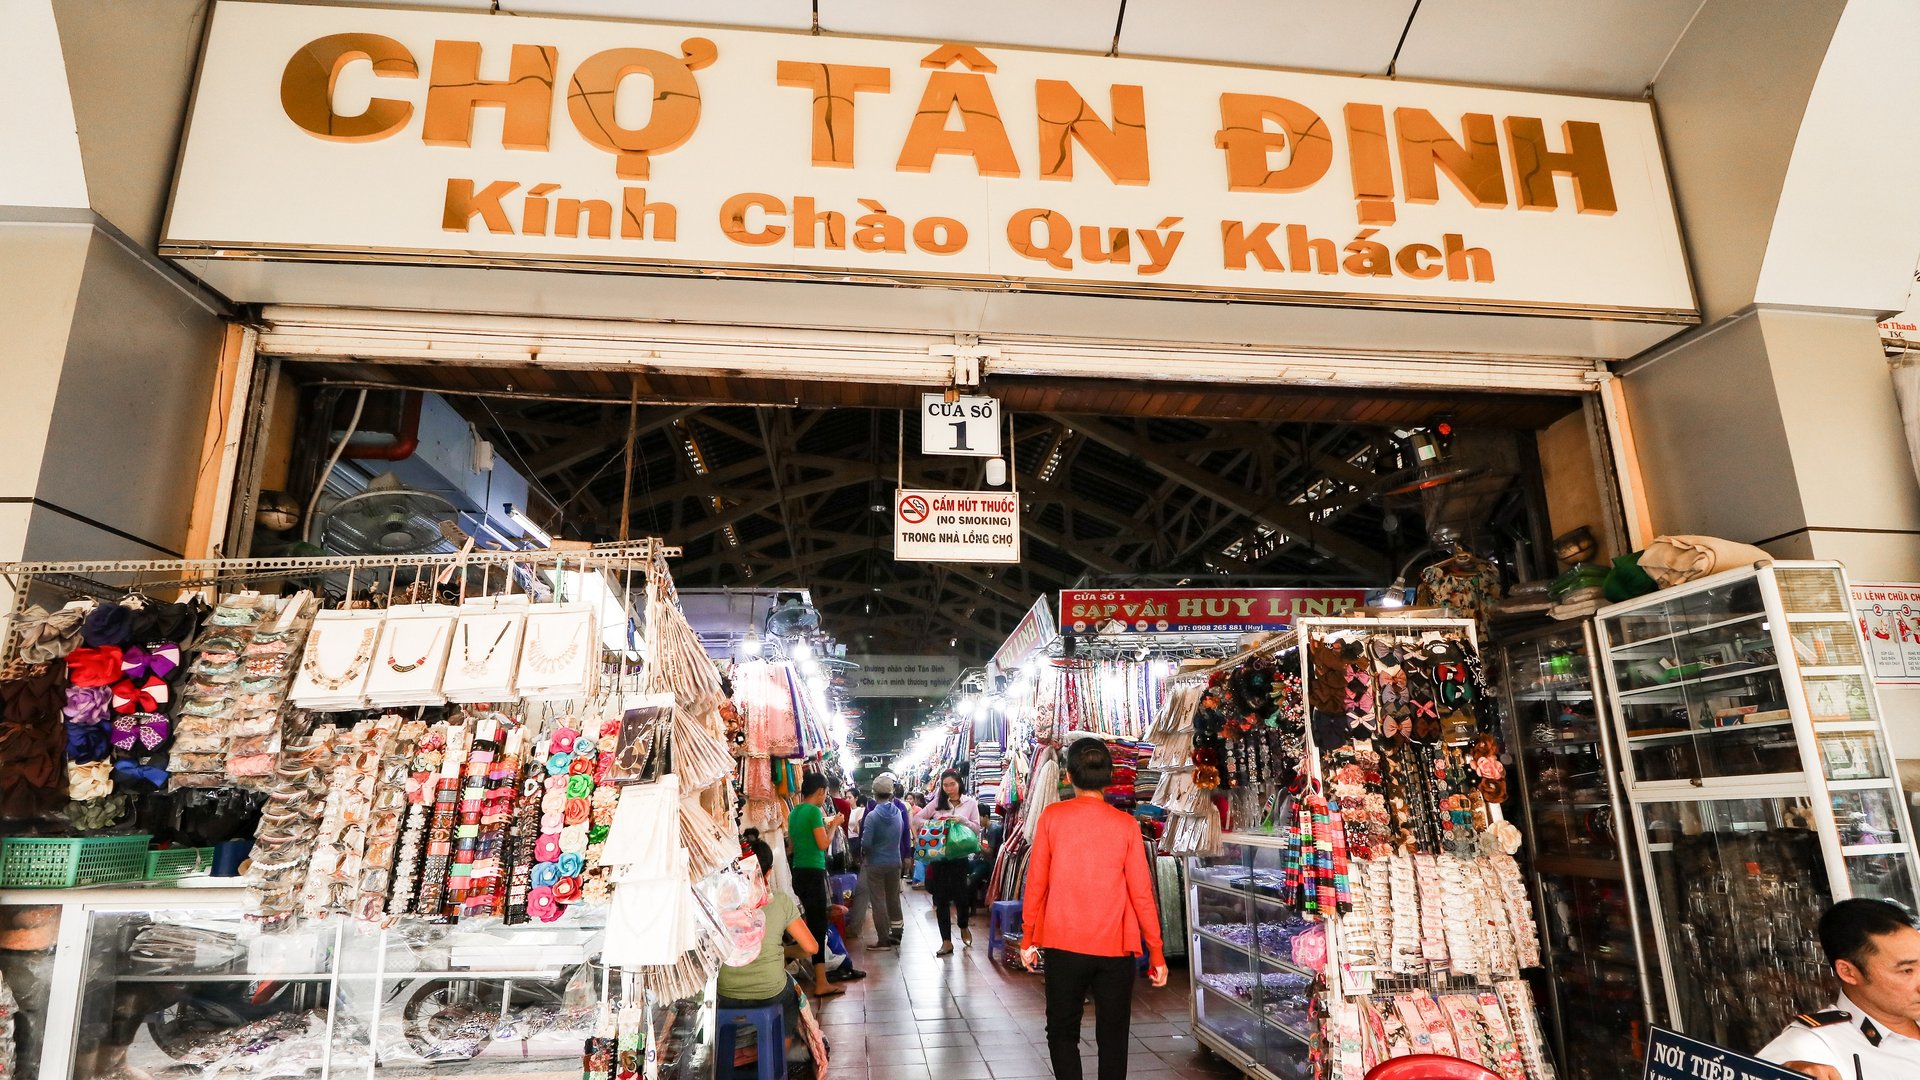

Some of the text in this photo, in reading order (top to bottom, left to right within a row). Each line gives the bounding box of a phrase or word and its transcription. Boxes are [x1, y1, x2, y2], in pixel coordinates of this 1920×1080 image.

[280, 32, 1618, 226] CHỢ TÂN ĐỊNH
[442, 178, 1495, 284] Kính Chào Quý Khách
[1890, 322, 1917, 331] Thanh
[970, 400, 994, 418] SỐ
[949, 421, 974, 451] 1
[933, 495, 1015, 513] CẤM HÚT THUỐC
[937, 516, 1012, 528] (NO SMOKING)
[902, 532, 936, 543] TRONG
[939, 531, 960, 544] NHÀ
[992, 533, 1013, 548] CHỢ
[1073, 592, 1097, 601] CỬA
[1099, 591, 1116, 601] SỐ
[1072, 598, 1357, 619] SẠP VẢI HUY LINH
[1245, 624, 1263, 632] (Huy)
[1654, 1042, 1735, 1080] NƠI TIẾP
